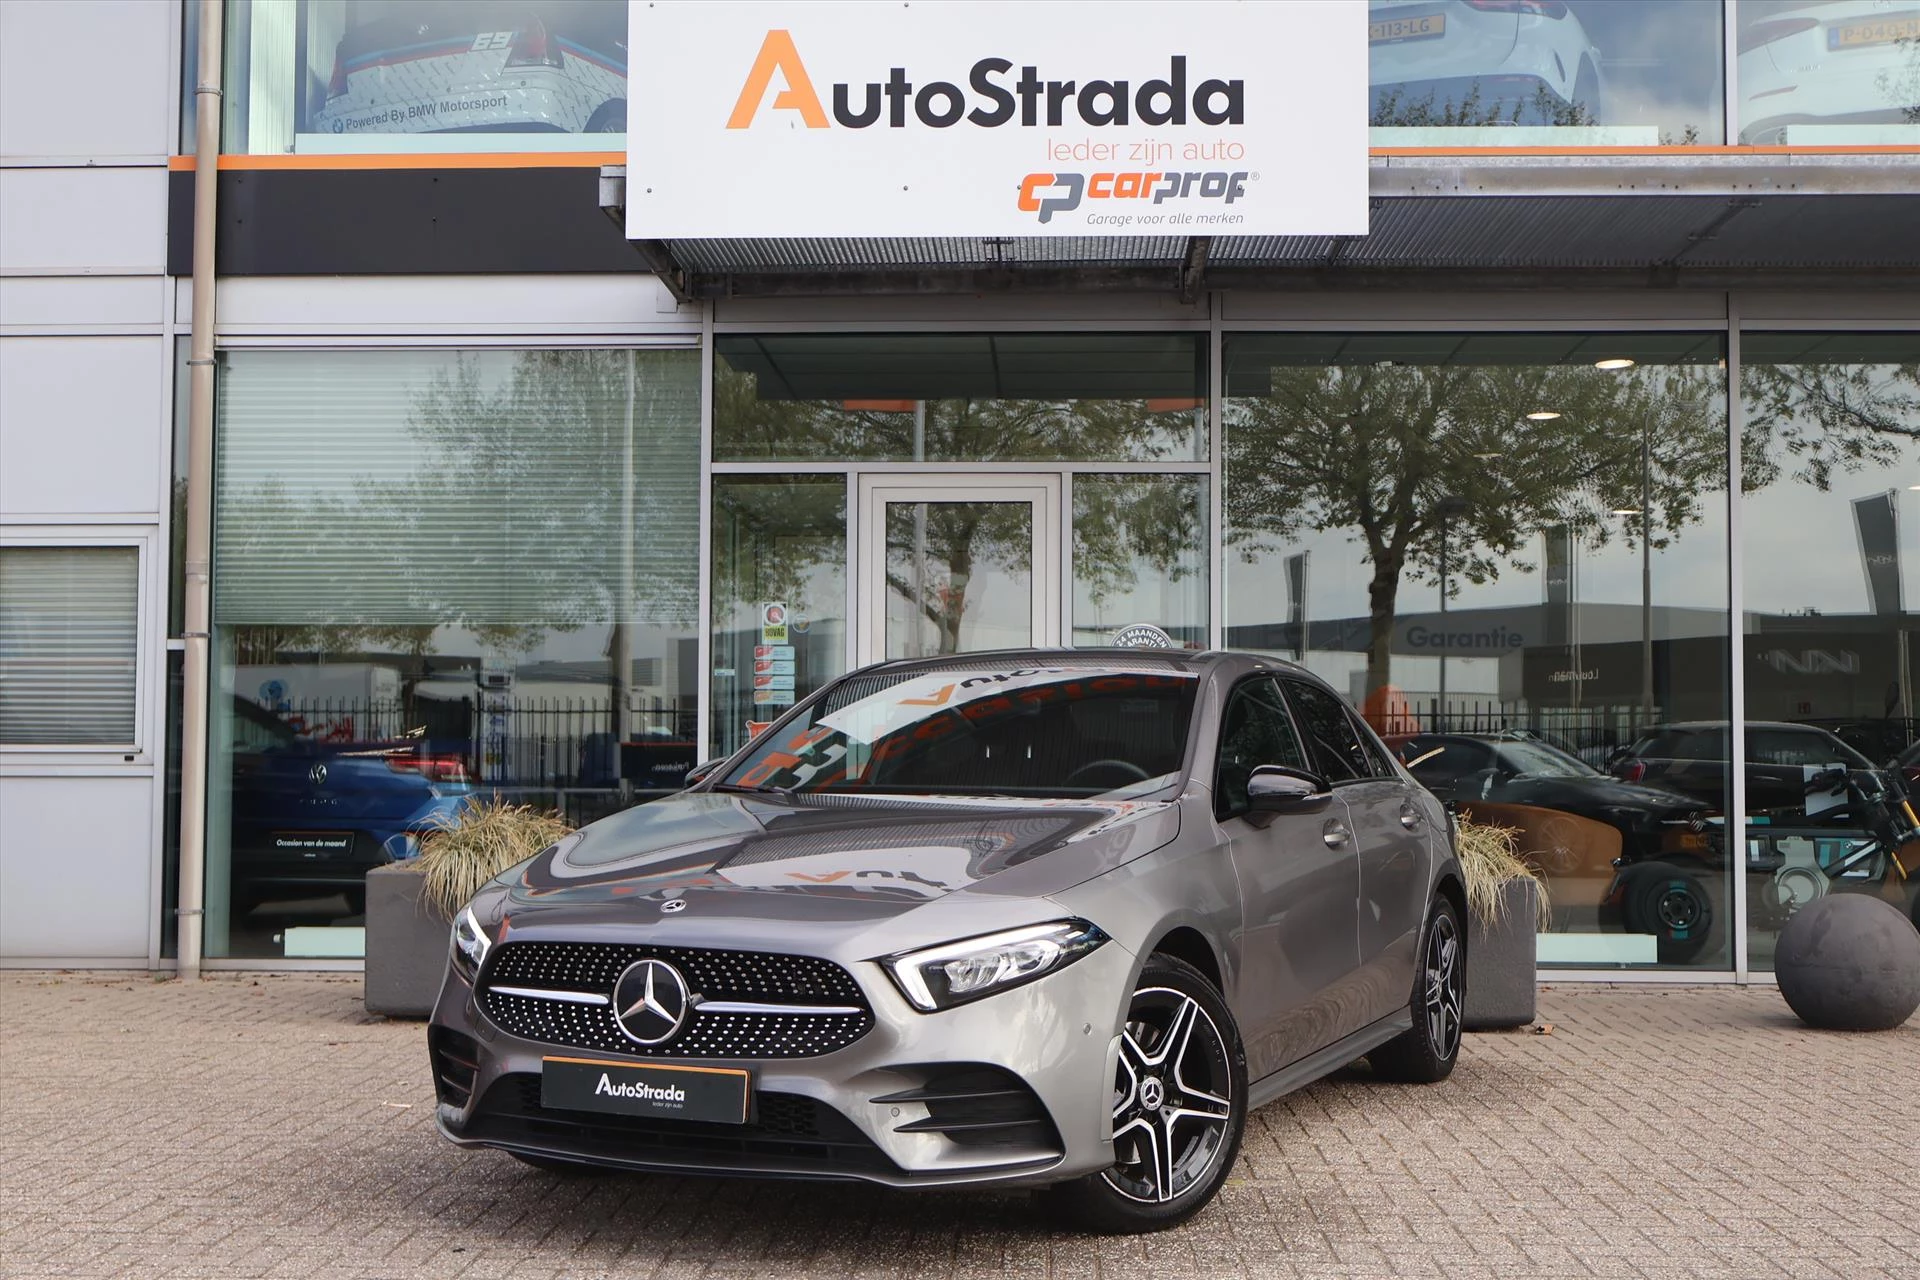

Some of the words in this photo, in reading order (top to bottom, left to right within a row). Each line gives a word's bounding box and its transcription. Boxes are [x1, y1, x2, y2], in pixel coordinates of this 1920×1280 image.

[470, 31, 513, 51] 69
[725, 28, 1245, 129] AutoStrada
[345, 112, 389, 130] Powered
[391, 109, 406, 122] By
[408, 103, 437, 118] BMW
[439, 95, 509, 113] Motorsport
[1048, 138, 1119, 161] Ieder
[1128, 139, 1173, 166] zijn
[1182, 139, 1245, 161] auto
[1087, 213, 1133, 228] Garage
[1136, 214, 1166, 225] voor
[1168, 212, 1192, 225] alle
[1195, 212, 1244, 225] merken
[764, 627, 785, 638] BOVAG
[1116, 635, 1127, 648] 24
[1126, 629, 1168, 648] MAANDEN
[1406, 625, 1524, 649] Garantie
[276, 838, 303, 848] Occasion
[315, 838, 323, 848] de
[324, 839, 346, 847] maand
[594, 1072, 685, 1102] AutoStrada
